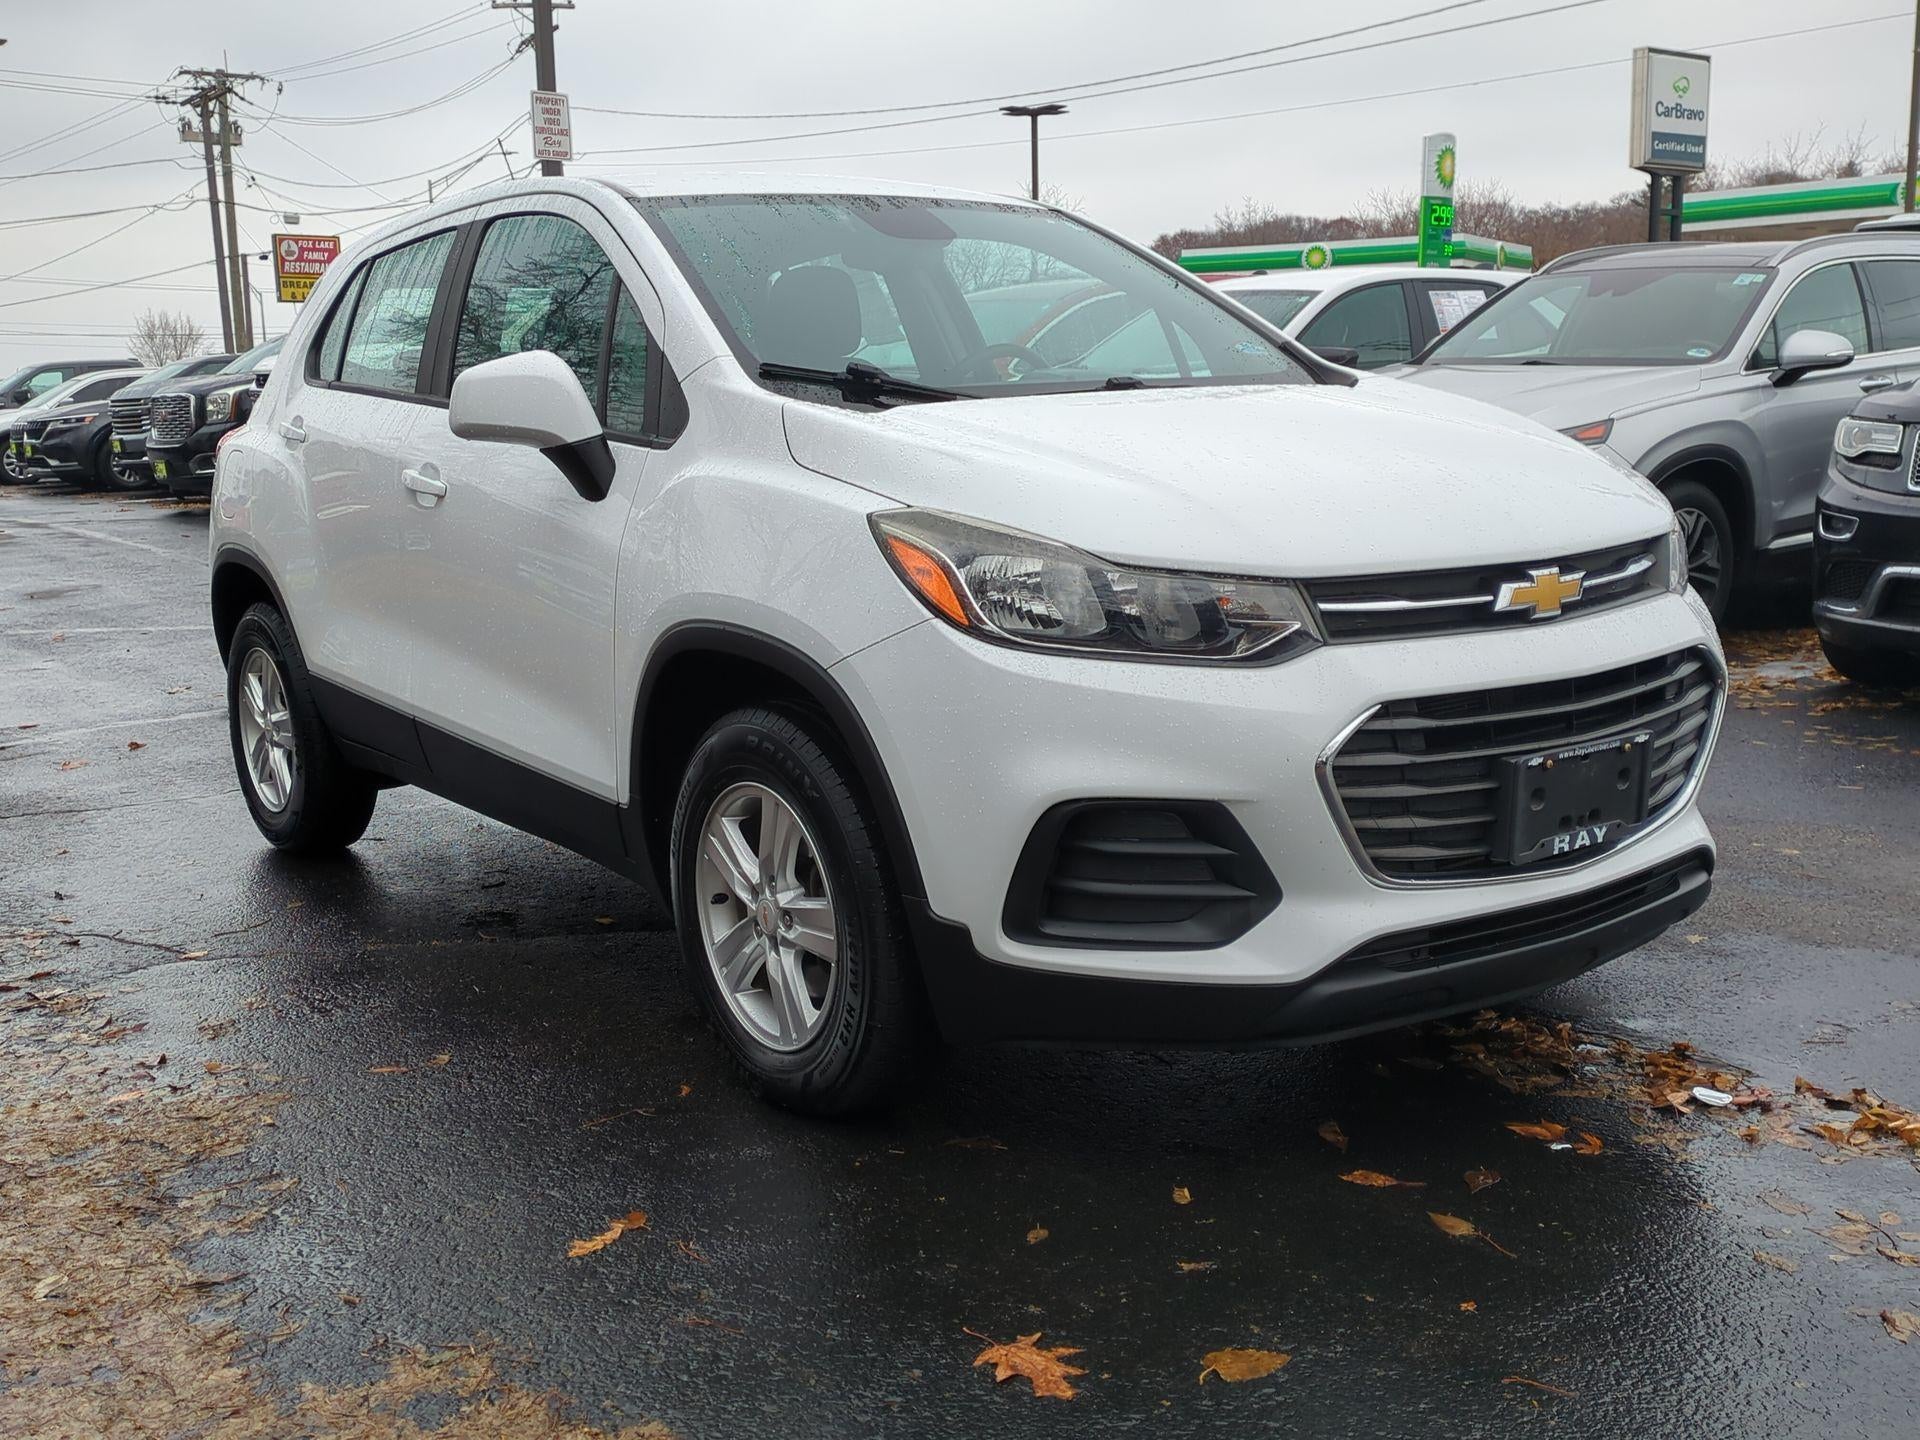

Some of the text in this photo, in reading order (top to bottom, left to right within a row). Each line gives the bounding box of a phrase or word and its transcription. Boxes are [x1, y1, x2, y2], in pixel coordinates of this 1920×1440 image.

[535, 96, 565, 107] PROPERTY
[541, 107, 561, 116] UNDER
[1655, 100, 1705, 122] CarBravo
[542, 117, 561, 126] VIDEO
[535, 126, 569, 137] SURVEILLANCE
[543, 136, 562, 148] Ray
[1654, 140, 1704, 154] Certified Used
[537, 149, 569, 158] AUTO GROUP
[298, 240, 335, 249] FOX LAKE
[303, 251, 329, 260] FAMILY
[1553, 825, 1609, 855] RAY
